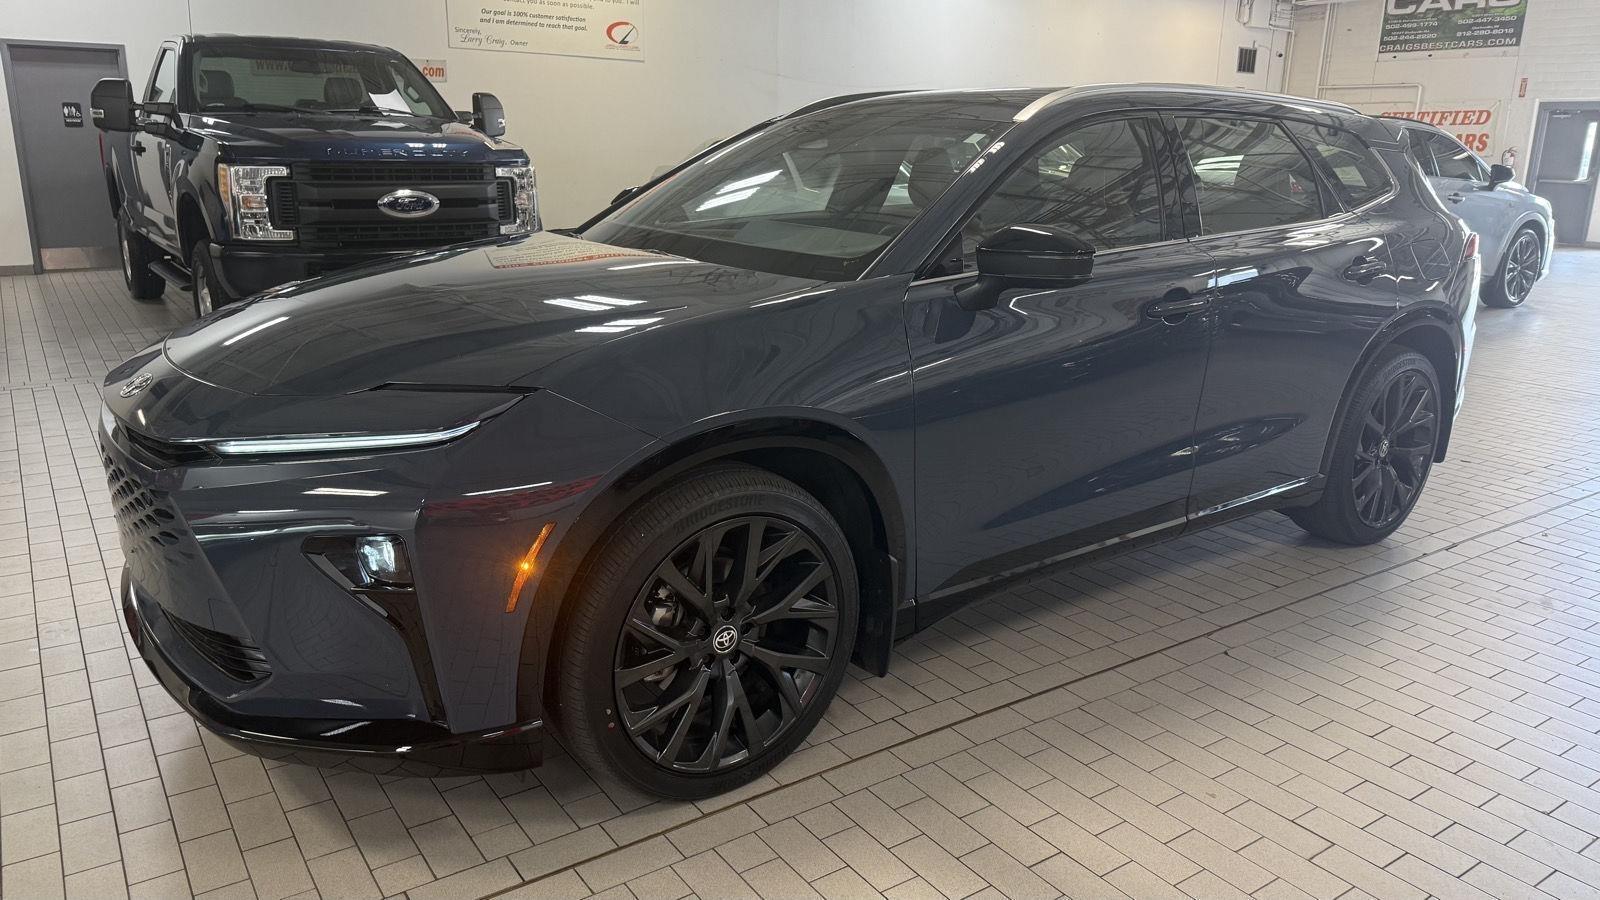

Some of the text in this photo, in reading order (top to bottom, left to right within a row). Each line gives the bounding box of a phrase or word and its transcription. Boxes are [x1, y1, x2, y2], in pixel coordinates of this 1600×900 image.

[506, 18, 538, 28] determined
[454, 26, 482, 35] Sincerely,
[510, 39, 528, 47] Owner
[1379, 37, 1517, 52] CRAIGSBESTCARS.COM
